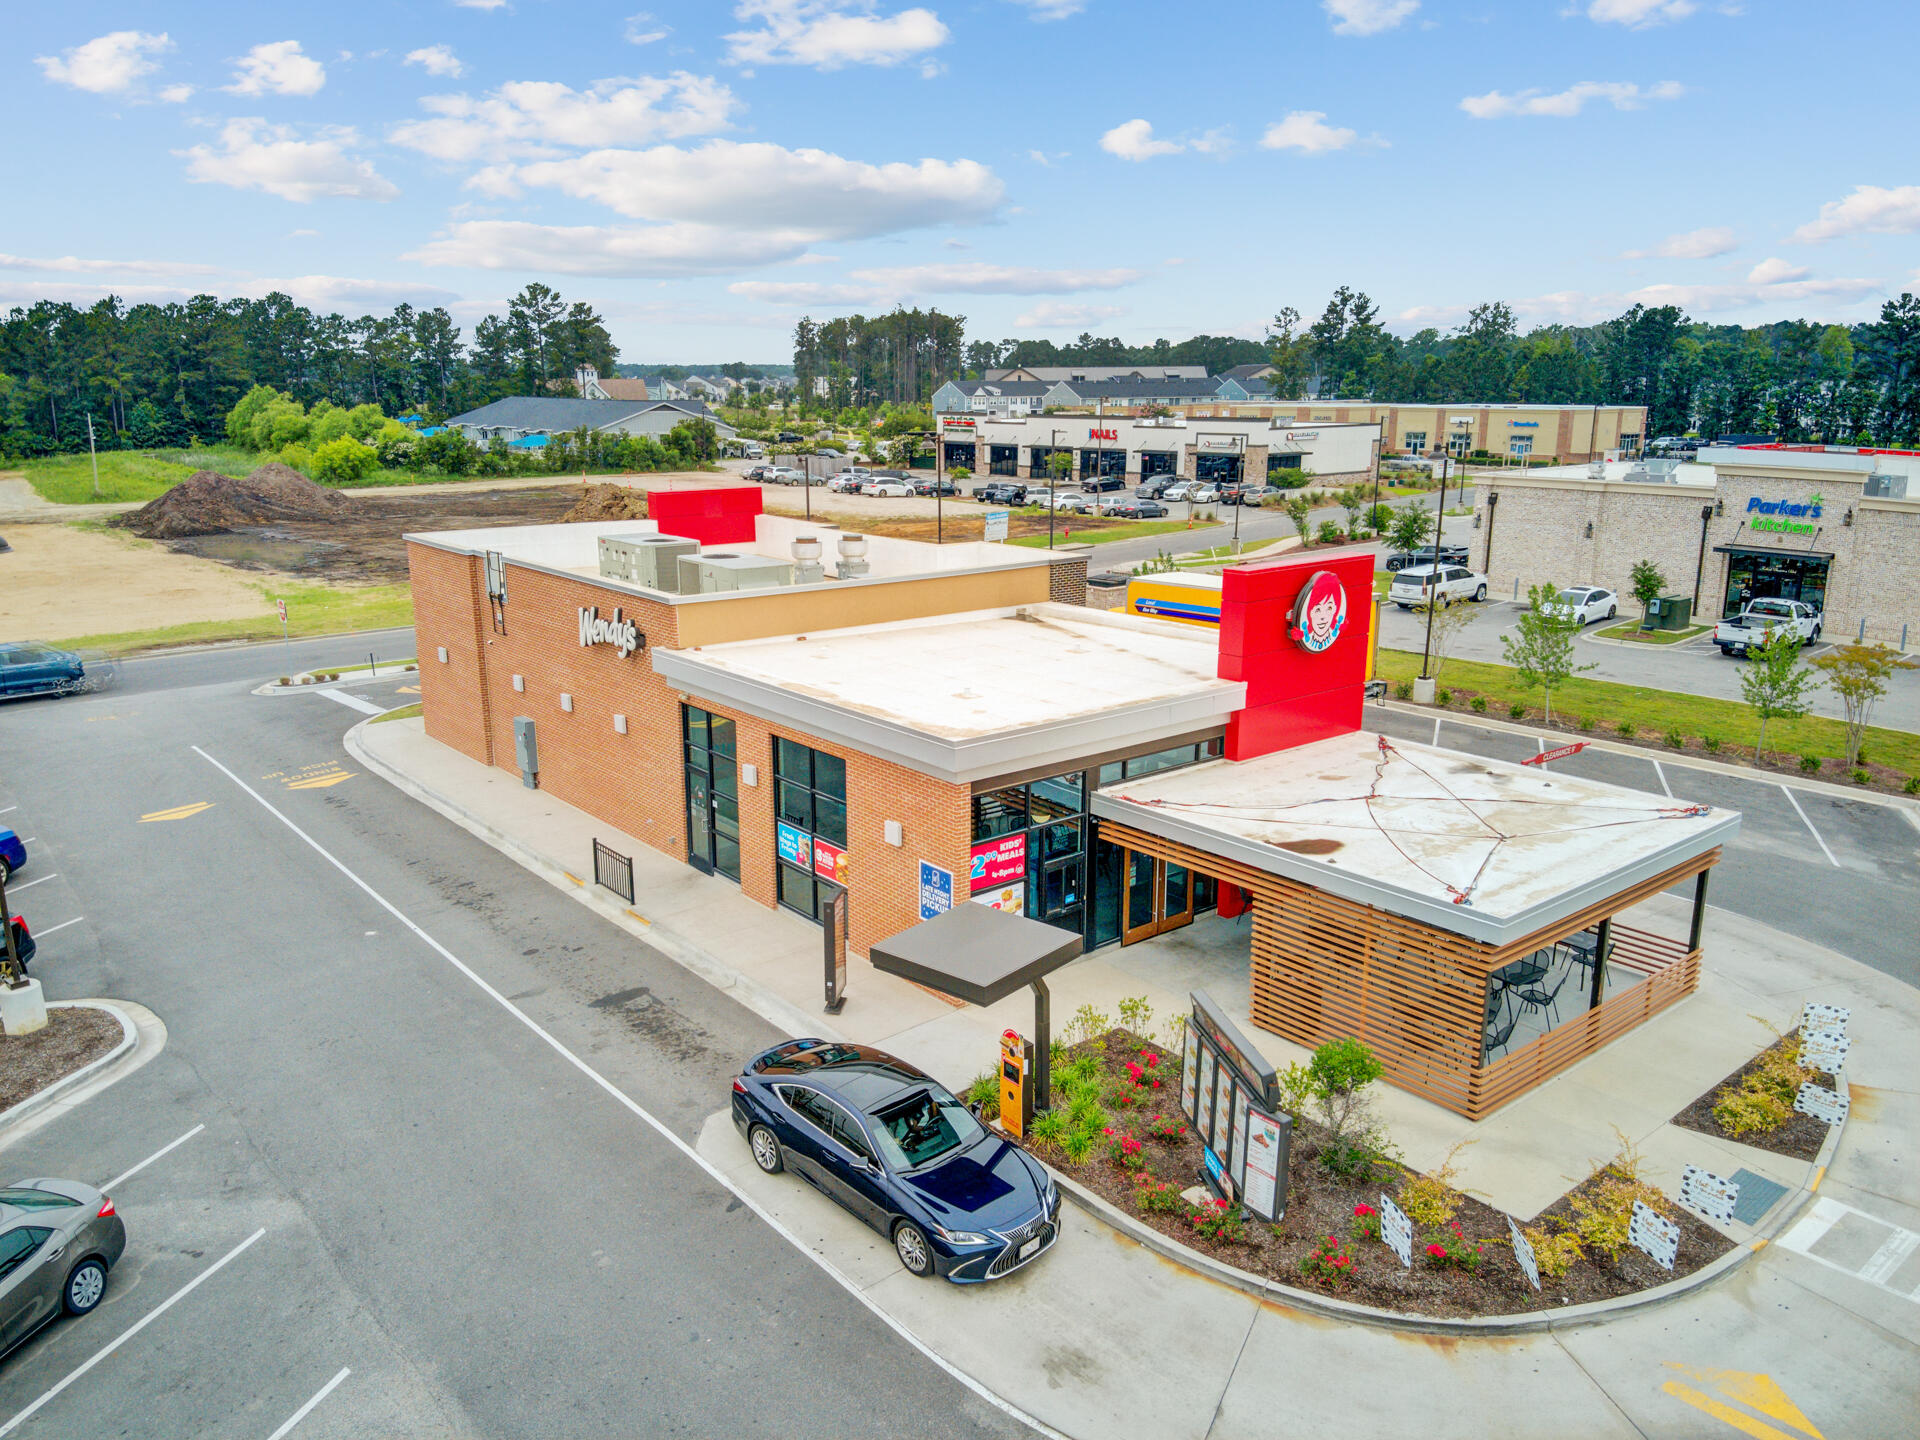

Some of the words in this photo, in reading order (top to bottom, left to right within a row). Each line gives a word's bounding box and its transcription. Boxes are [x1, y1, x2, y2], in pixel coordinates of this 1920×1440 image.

[1750, 516, 1813, 535] kitchen
[578, 606, 637, 659] Wendy's
[1543, 747, 1571, 761] CLEARANCE
[996, 848, 1025, 863] MEALS
[922, 883, 936, 894] LATE
[934, 888, 950, 901] NIGHT
[922, 890, 950, 908] DELIVERY
